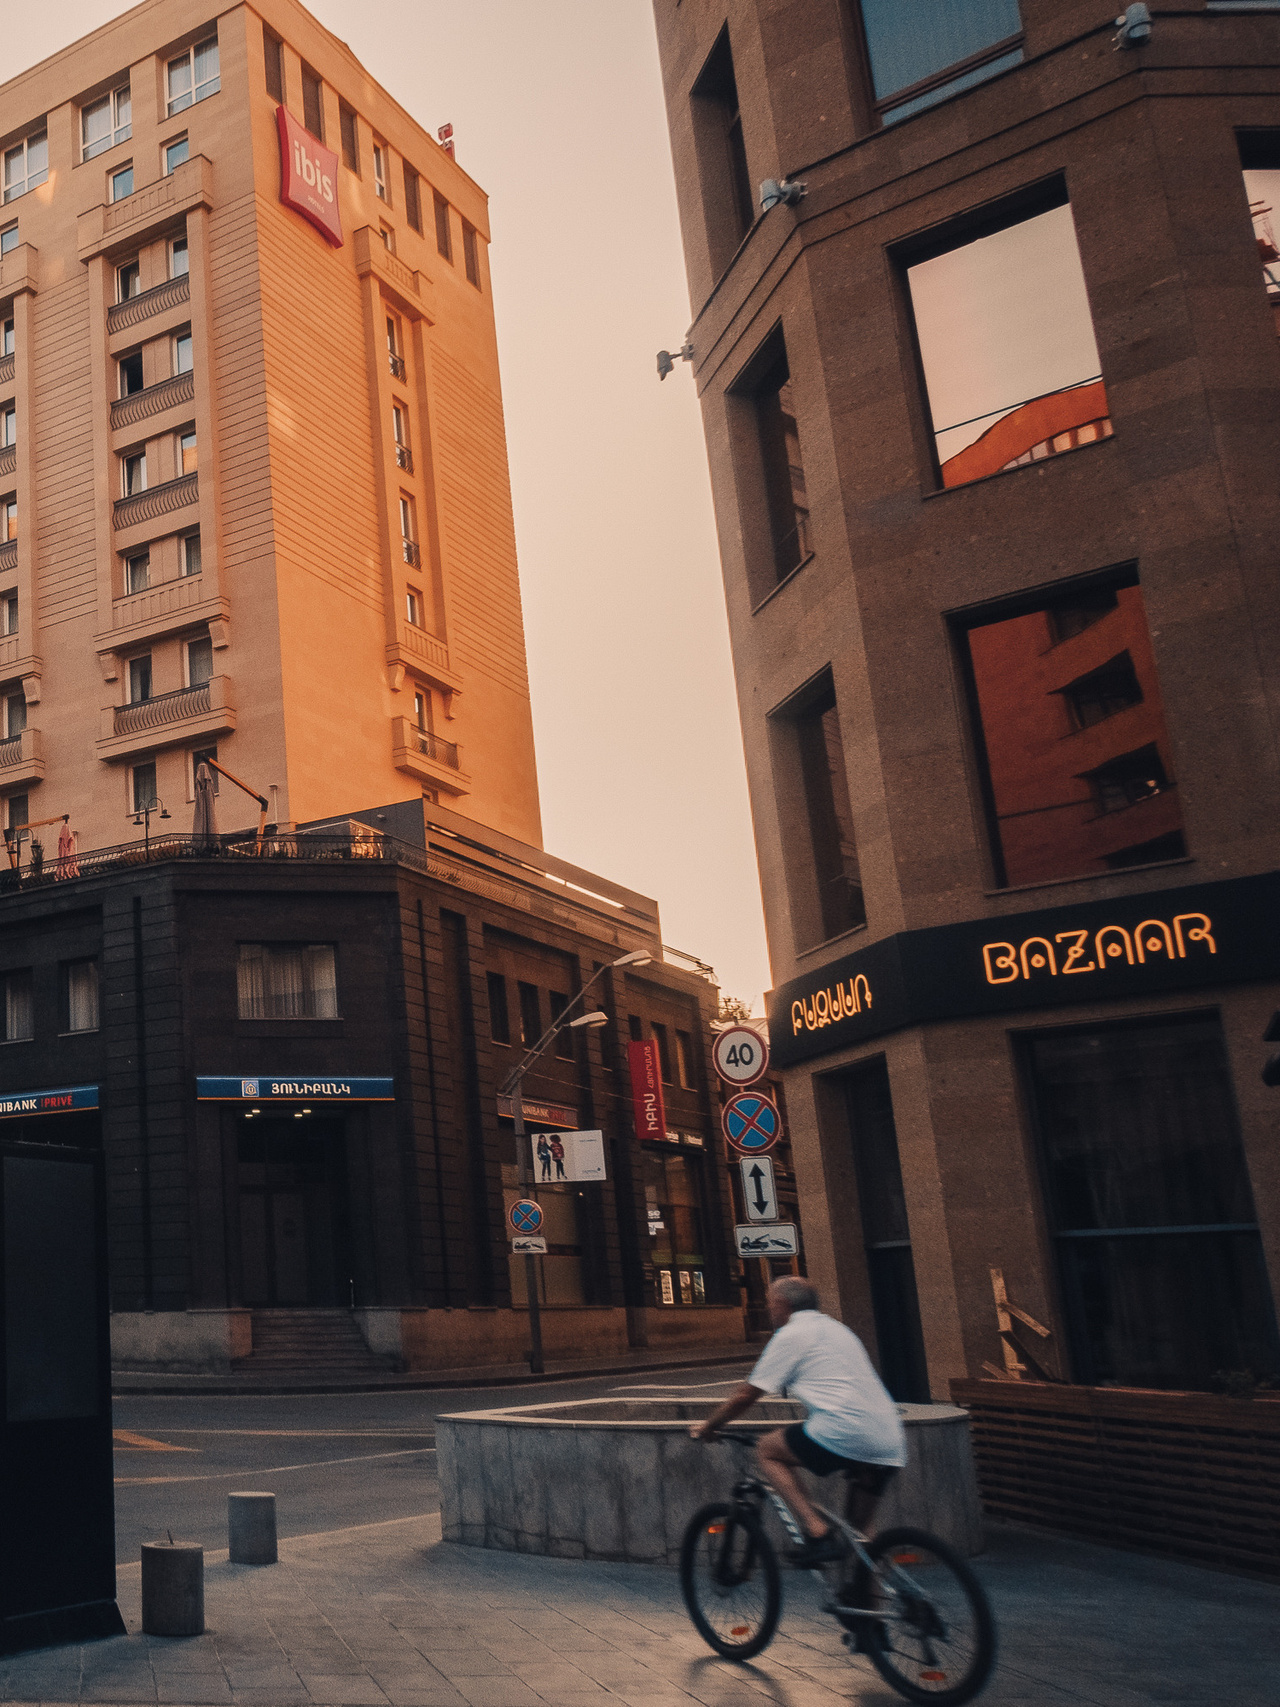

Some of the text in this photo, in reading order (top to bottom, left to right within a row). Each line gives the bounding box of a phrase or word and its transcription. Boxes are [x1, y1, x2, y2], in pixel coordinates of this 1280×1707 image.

[293, 139, 334, 203] ibis
[982, 912, 1217, 984] BAZAAR
[726, 1043, 754, 1067] 40
[271, 1082, 351, 1095] ՅՈՒՆԻԲԱՆԿ
